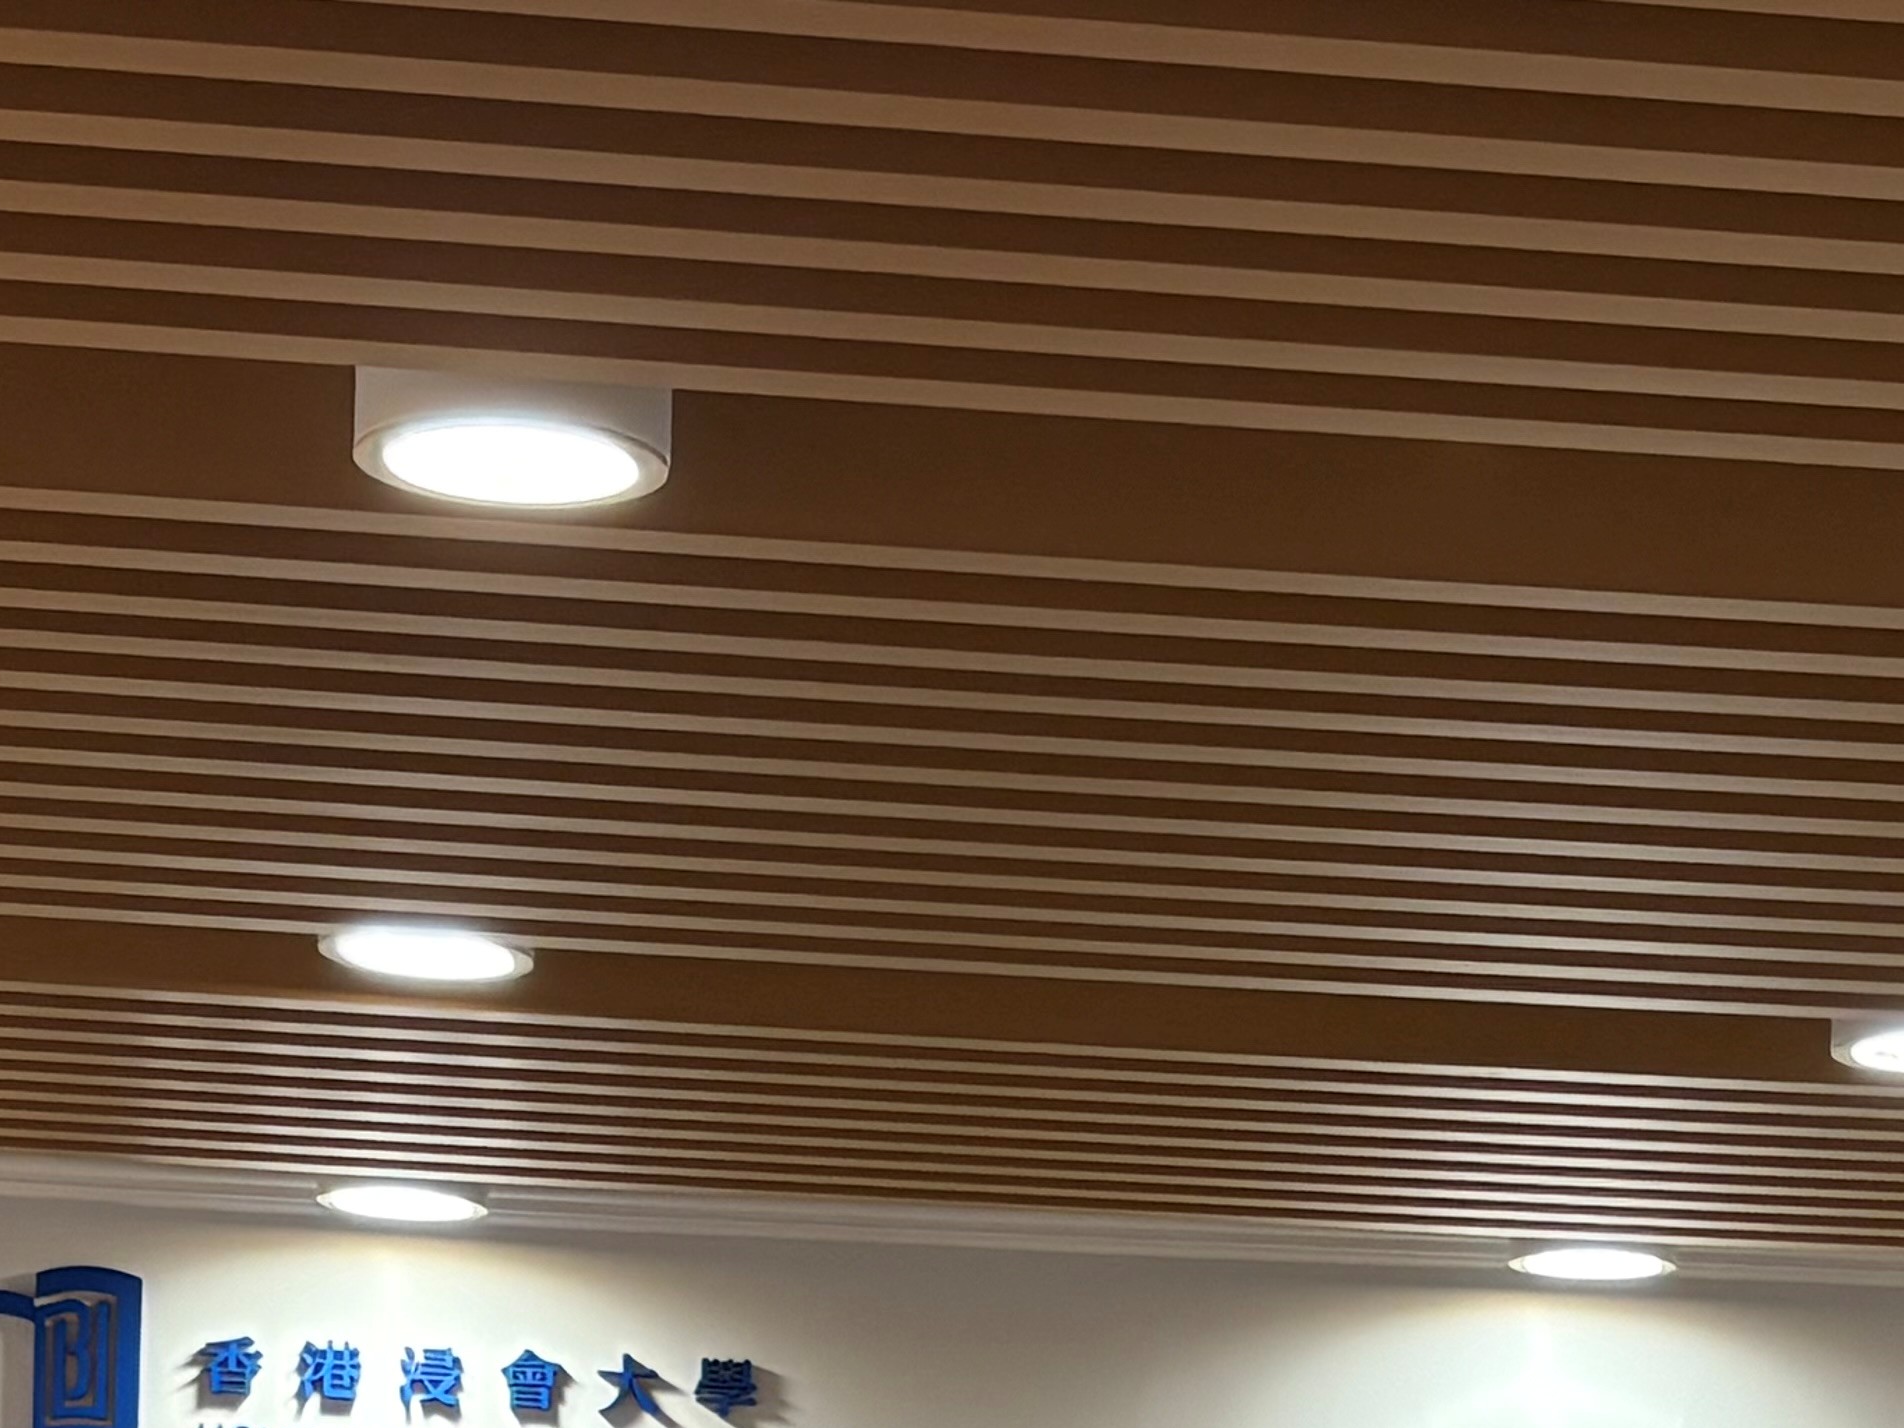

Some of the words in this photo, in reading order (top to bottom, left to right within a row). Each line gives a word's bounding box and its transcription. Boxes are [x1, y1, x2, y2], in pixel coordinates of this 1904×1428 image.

[200, 1336, 758, 1417] 香港浸會大學
